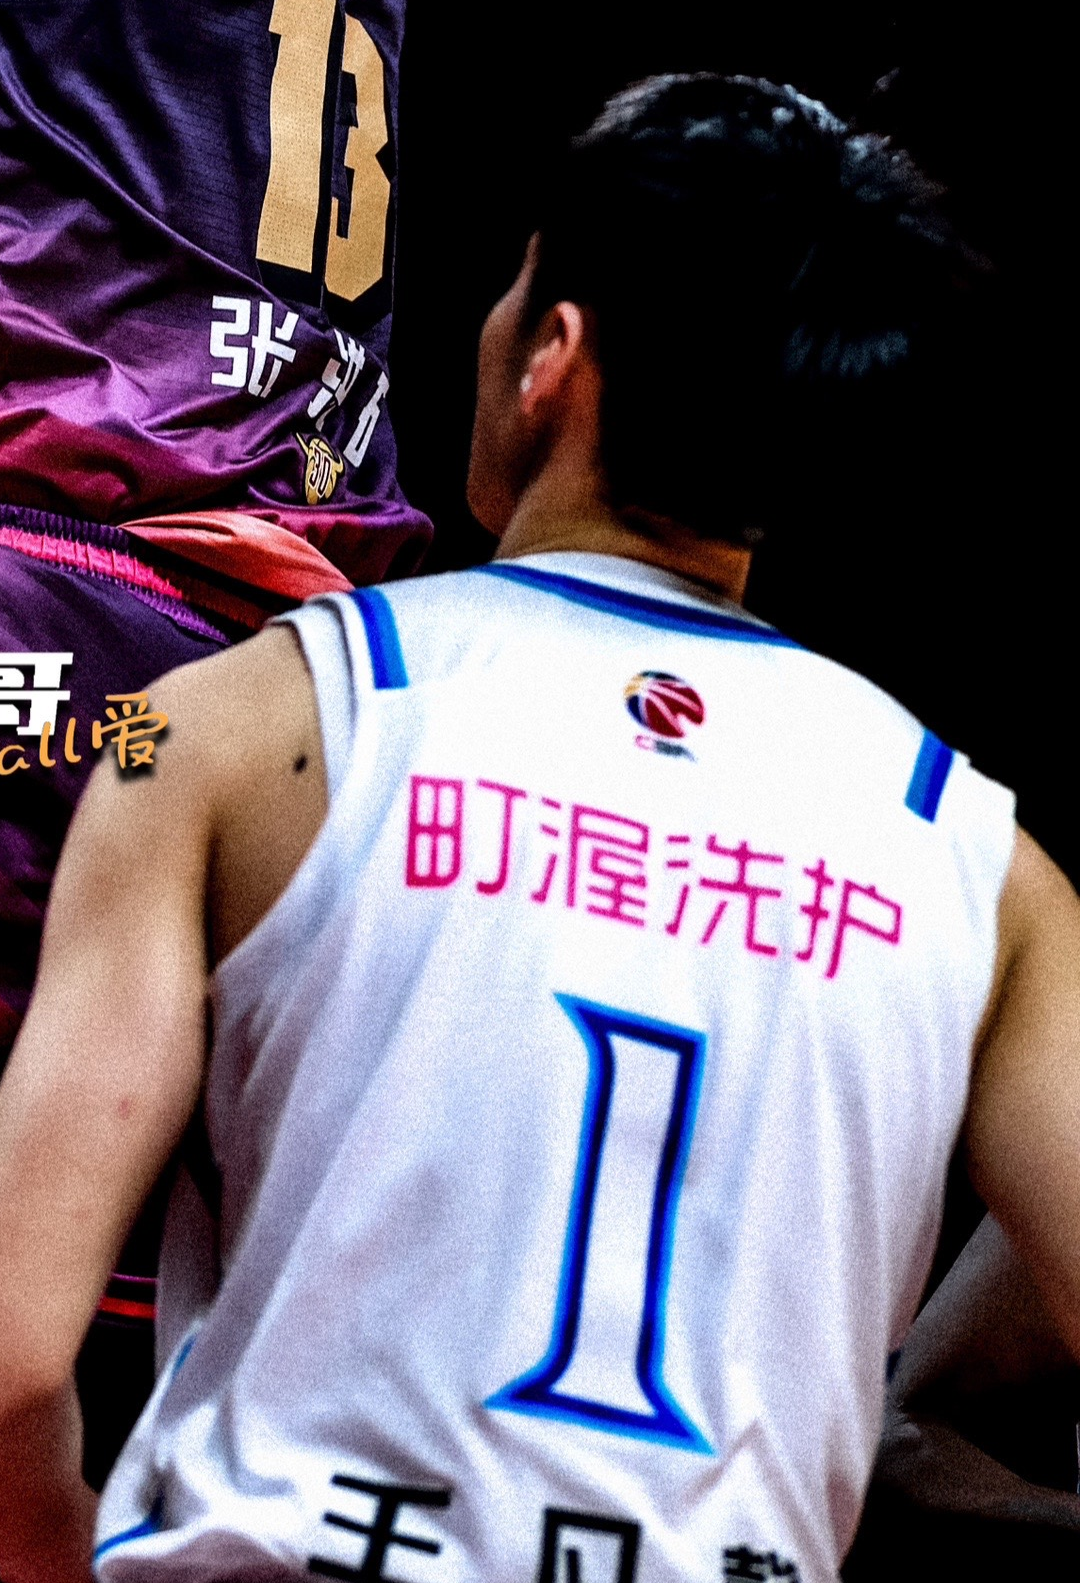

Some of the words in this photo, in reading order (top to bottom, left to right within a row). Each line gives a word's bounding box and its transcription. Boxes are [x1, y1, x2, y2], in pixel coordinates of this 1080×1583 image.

[405, 774, 903, 980] 町渥洗护
[482, 991, 717, 1457] 1
